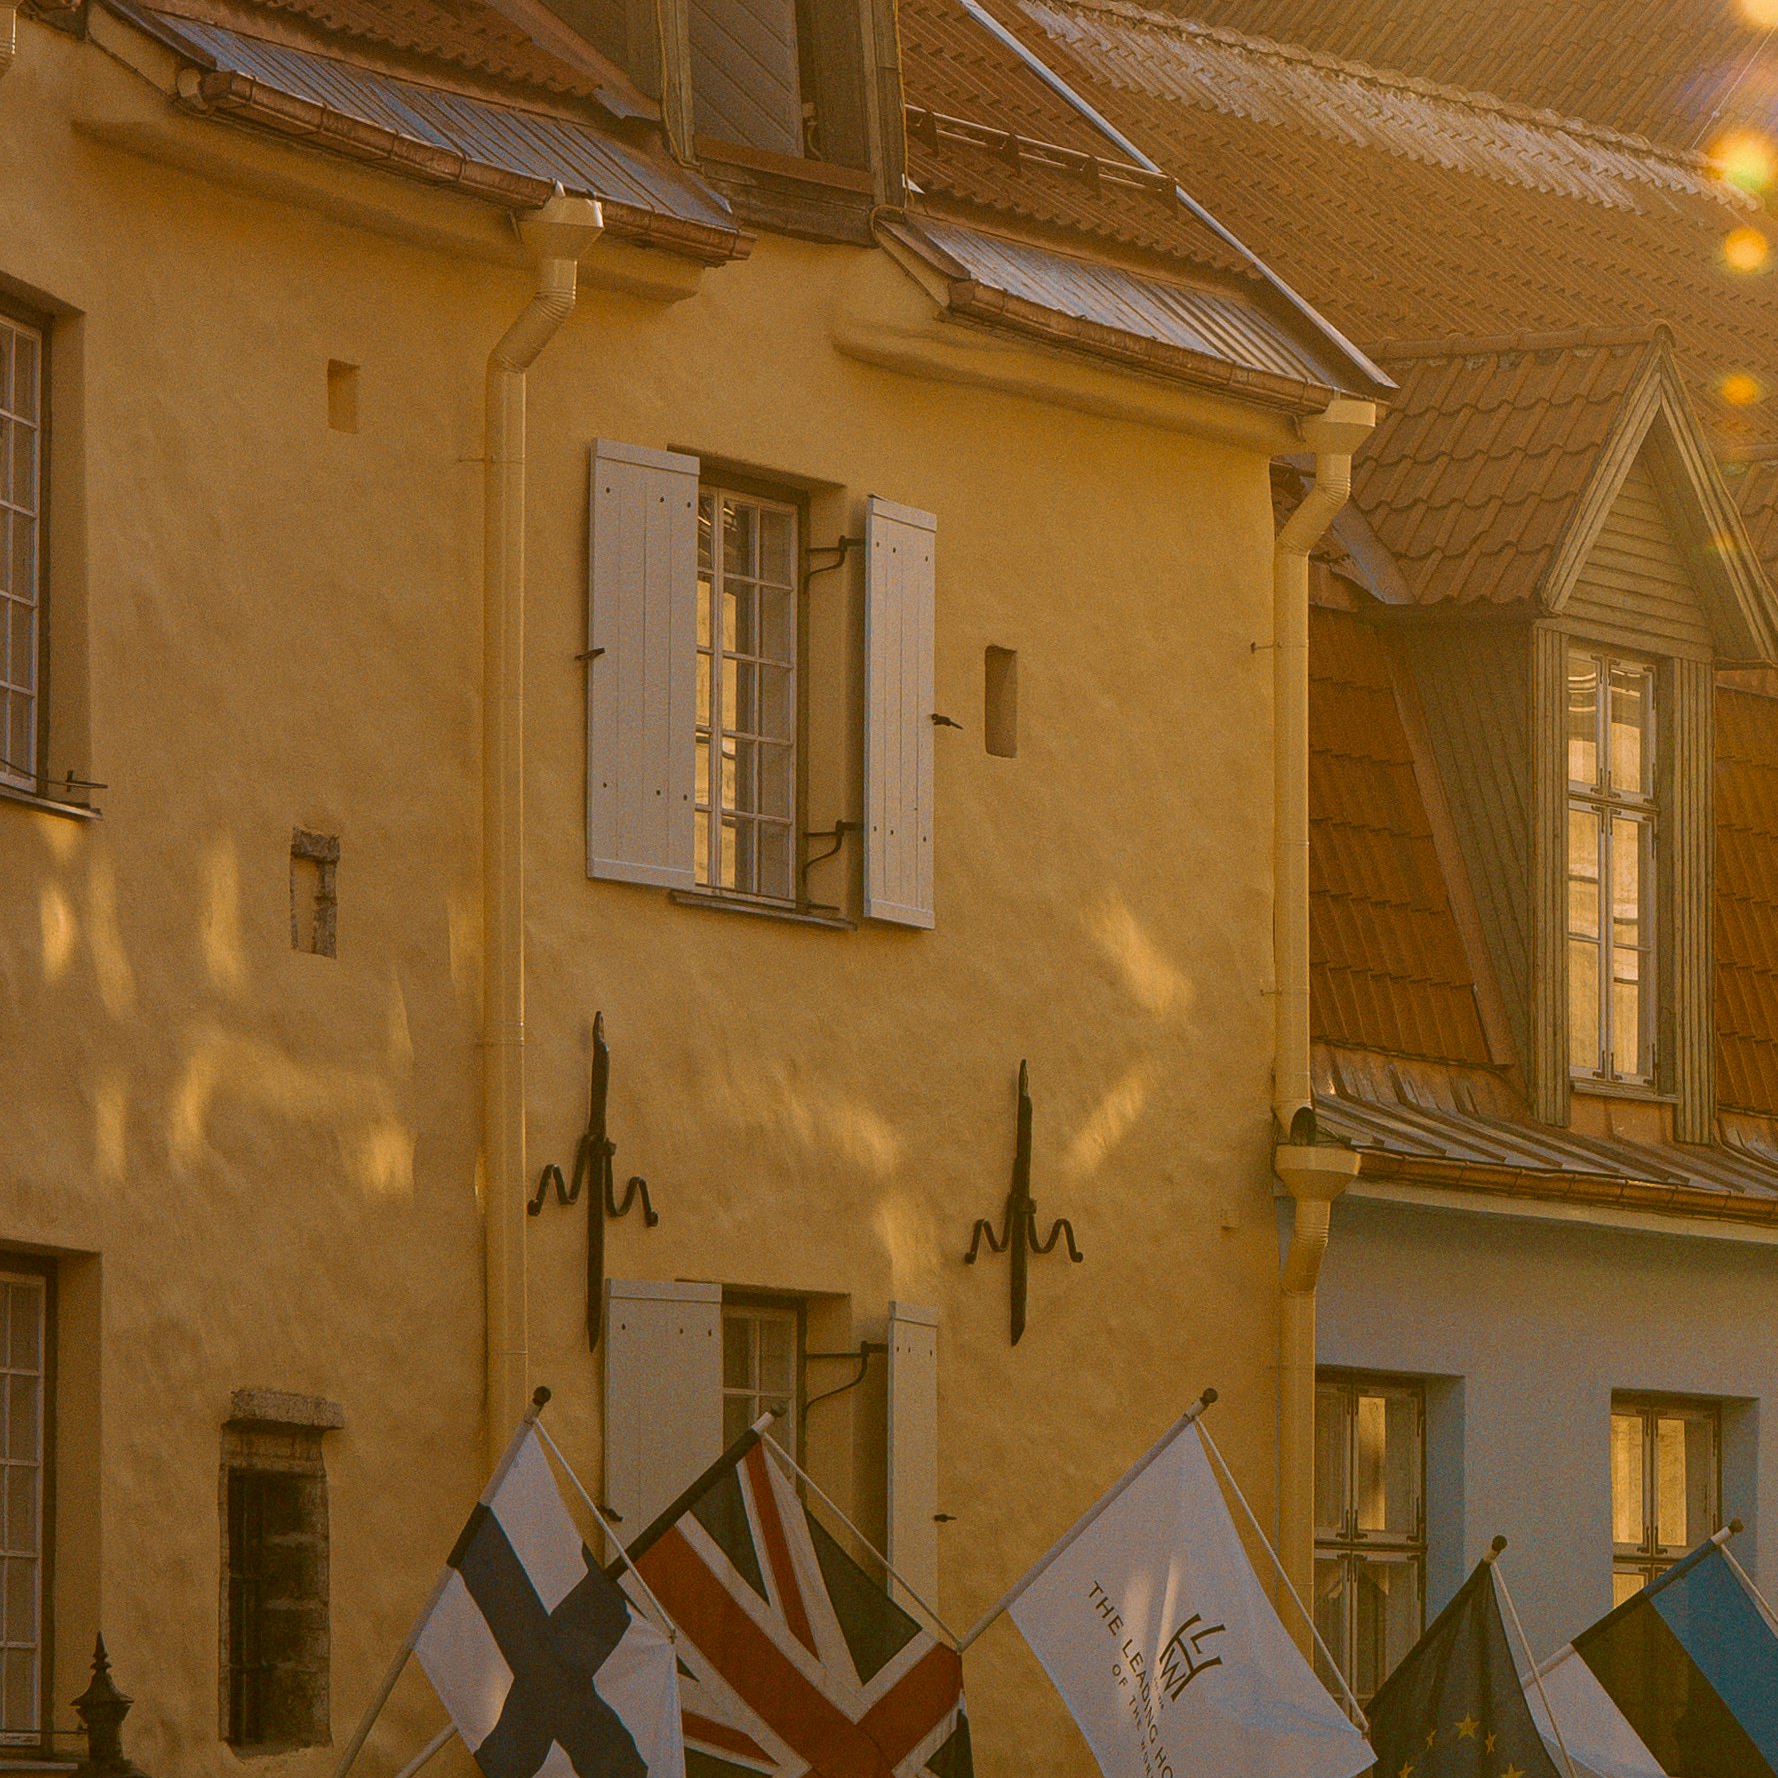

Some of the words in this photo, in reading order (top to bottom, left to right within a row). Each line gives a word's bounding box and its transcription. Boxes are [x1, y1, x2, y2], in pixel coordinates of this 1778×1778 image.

[1089, 1580, 1124, 1636] THE
[1121, 1638, 1159, 1744] LEADING
[1112, 1663, 1128, 1686] OF
